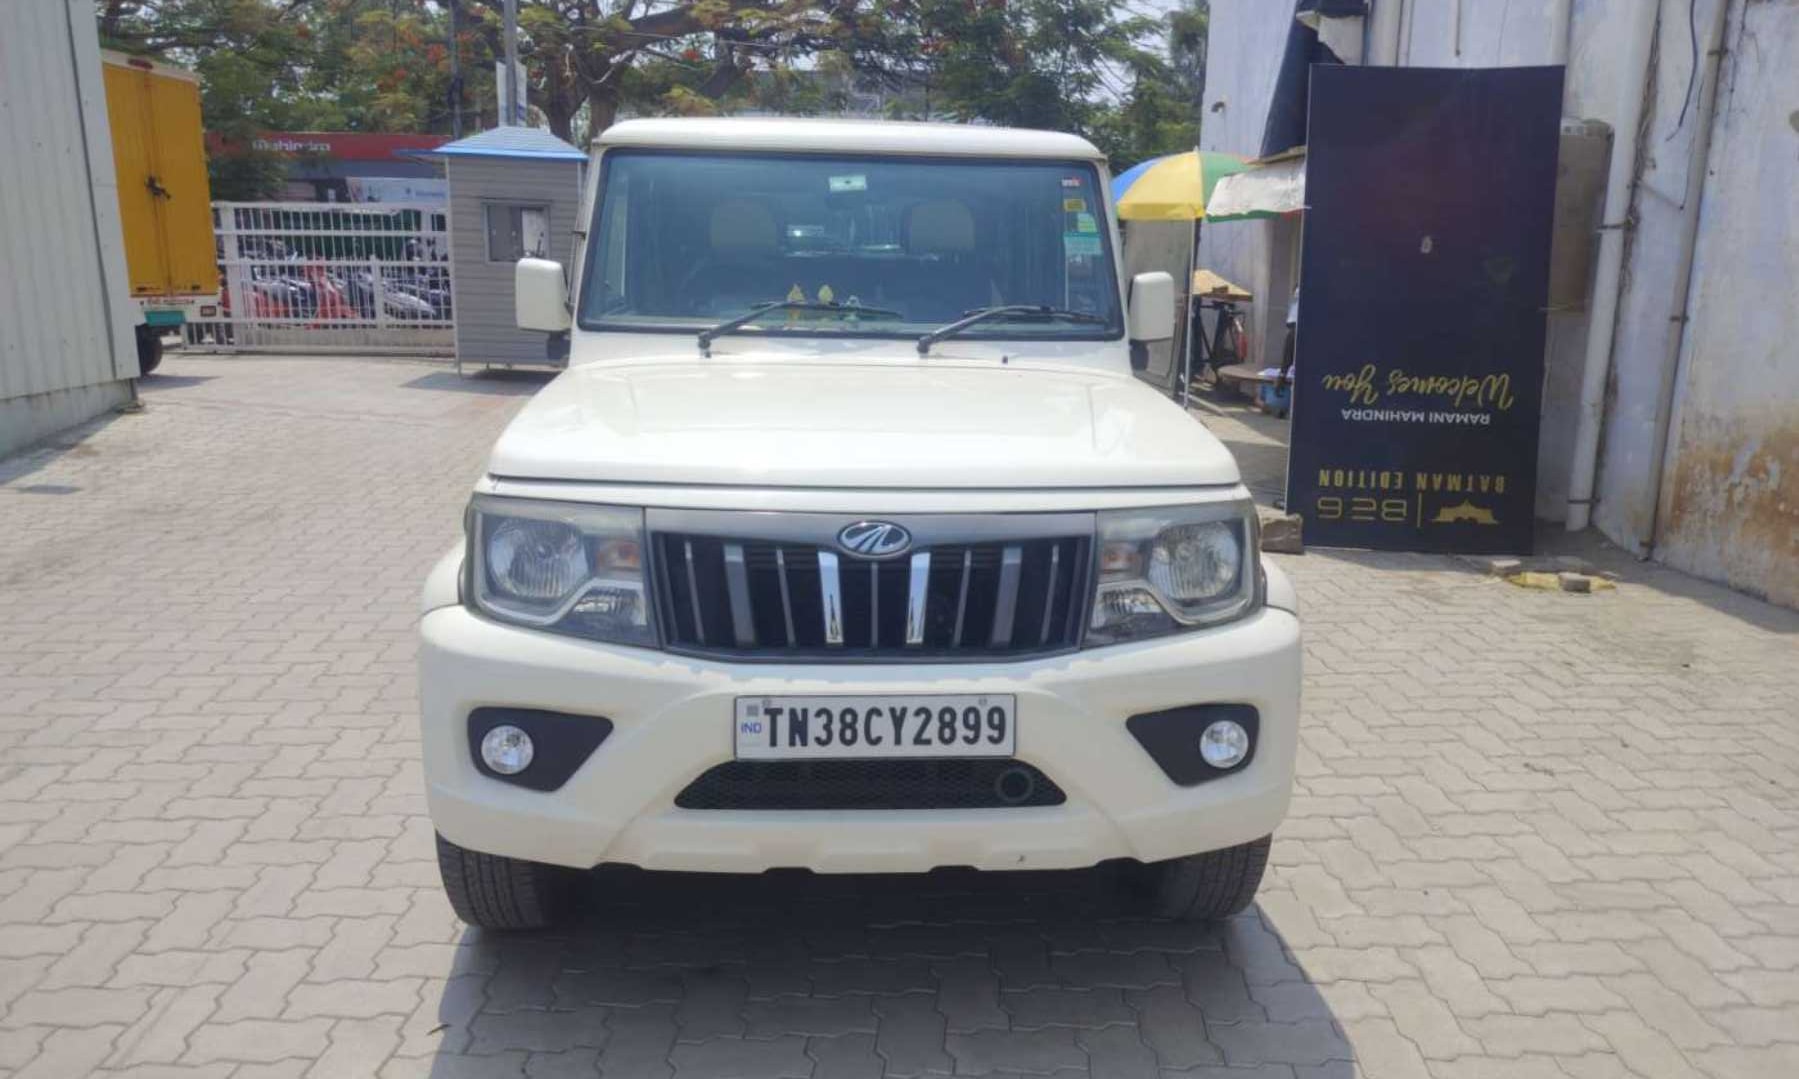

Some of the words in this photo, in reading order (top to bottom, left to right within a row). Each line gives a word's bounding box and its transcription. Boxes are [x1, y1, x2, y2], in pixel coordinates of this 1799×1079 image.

[1322, 364, 1378, 404] You
[1387, 371, 1513, 409] Welcomes
[1341, 409, 1424, 423] MAHINDRA
[1429, 412, 1490, 425] RAMANI
[1319, 470, 1403, 489] EDITION
[1417, 472, 1504, 493] BATMAN
[740, 722, 762, 734] IND
[764, 706, 1007, 747] TN38CY2899
